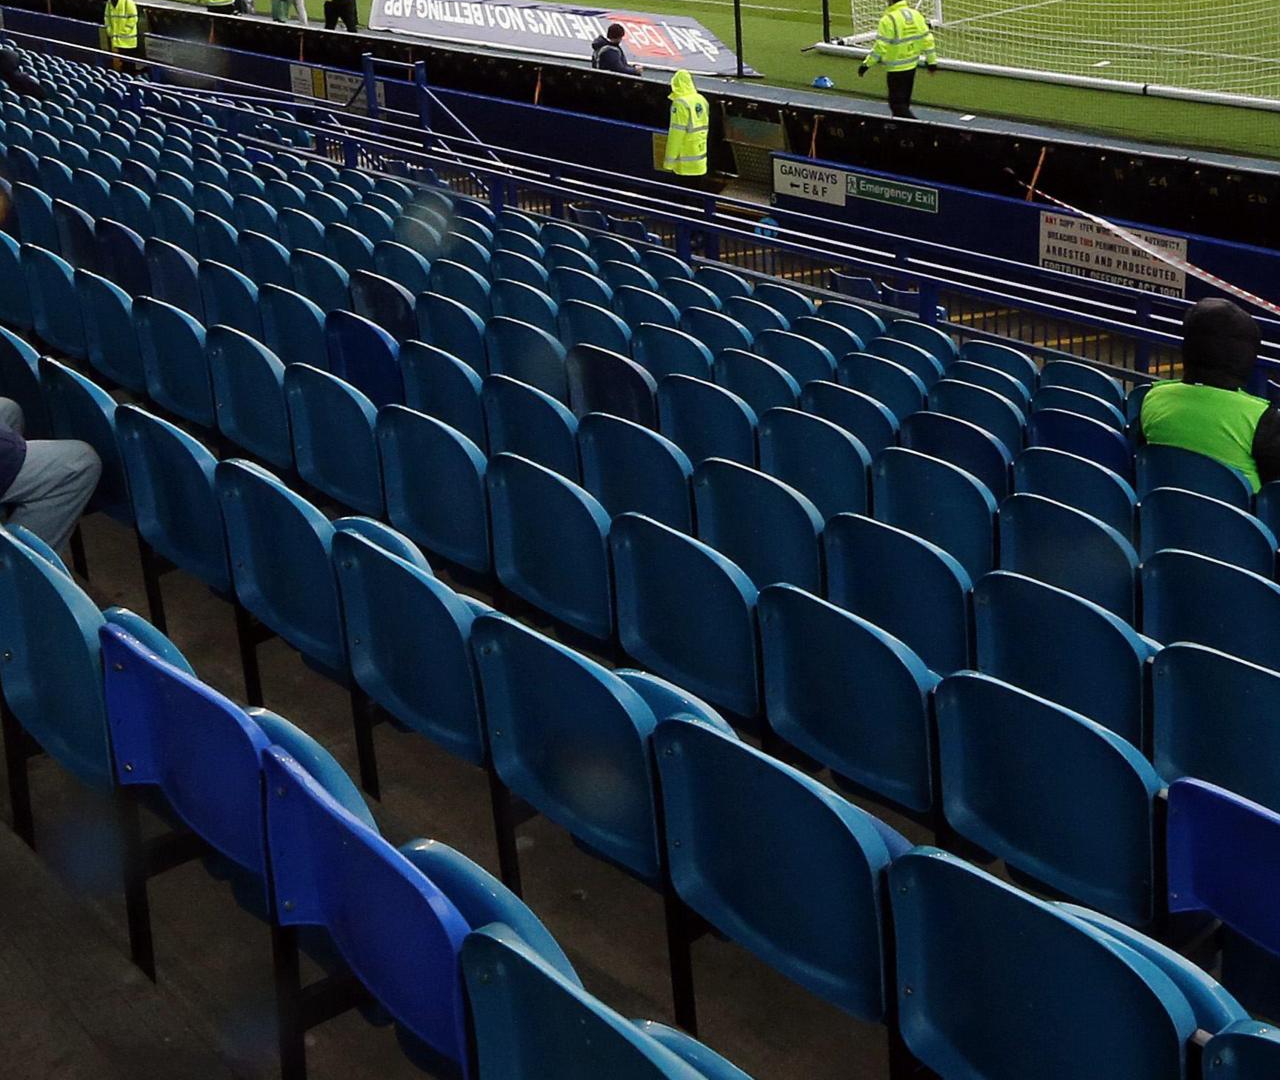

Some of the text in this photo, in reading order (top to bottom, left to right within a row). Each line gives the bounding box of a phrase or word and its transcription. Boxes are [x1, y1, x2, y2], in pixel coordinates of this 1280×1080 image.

[525, 8, 568, 38] UK'S
[780, 164, 838, 185] GANGWAYS
[803, 183, 810, 193] E
[821, 186, 828, 197] F
[859, 180, 935, 206] Emergency Exit
[1046, 245, 1180, 283] ARRESTED AND PROSECUTED.
